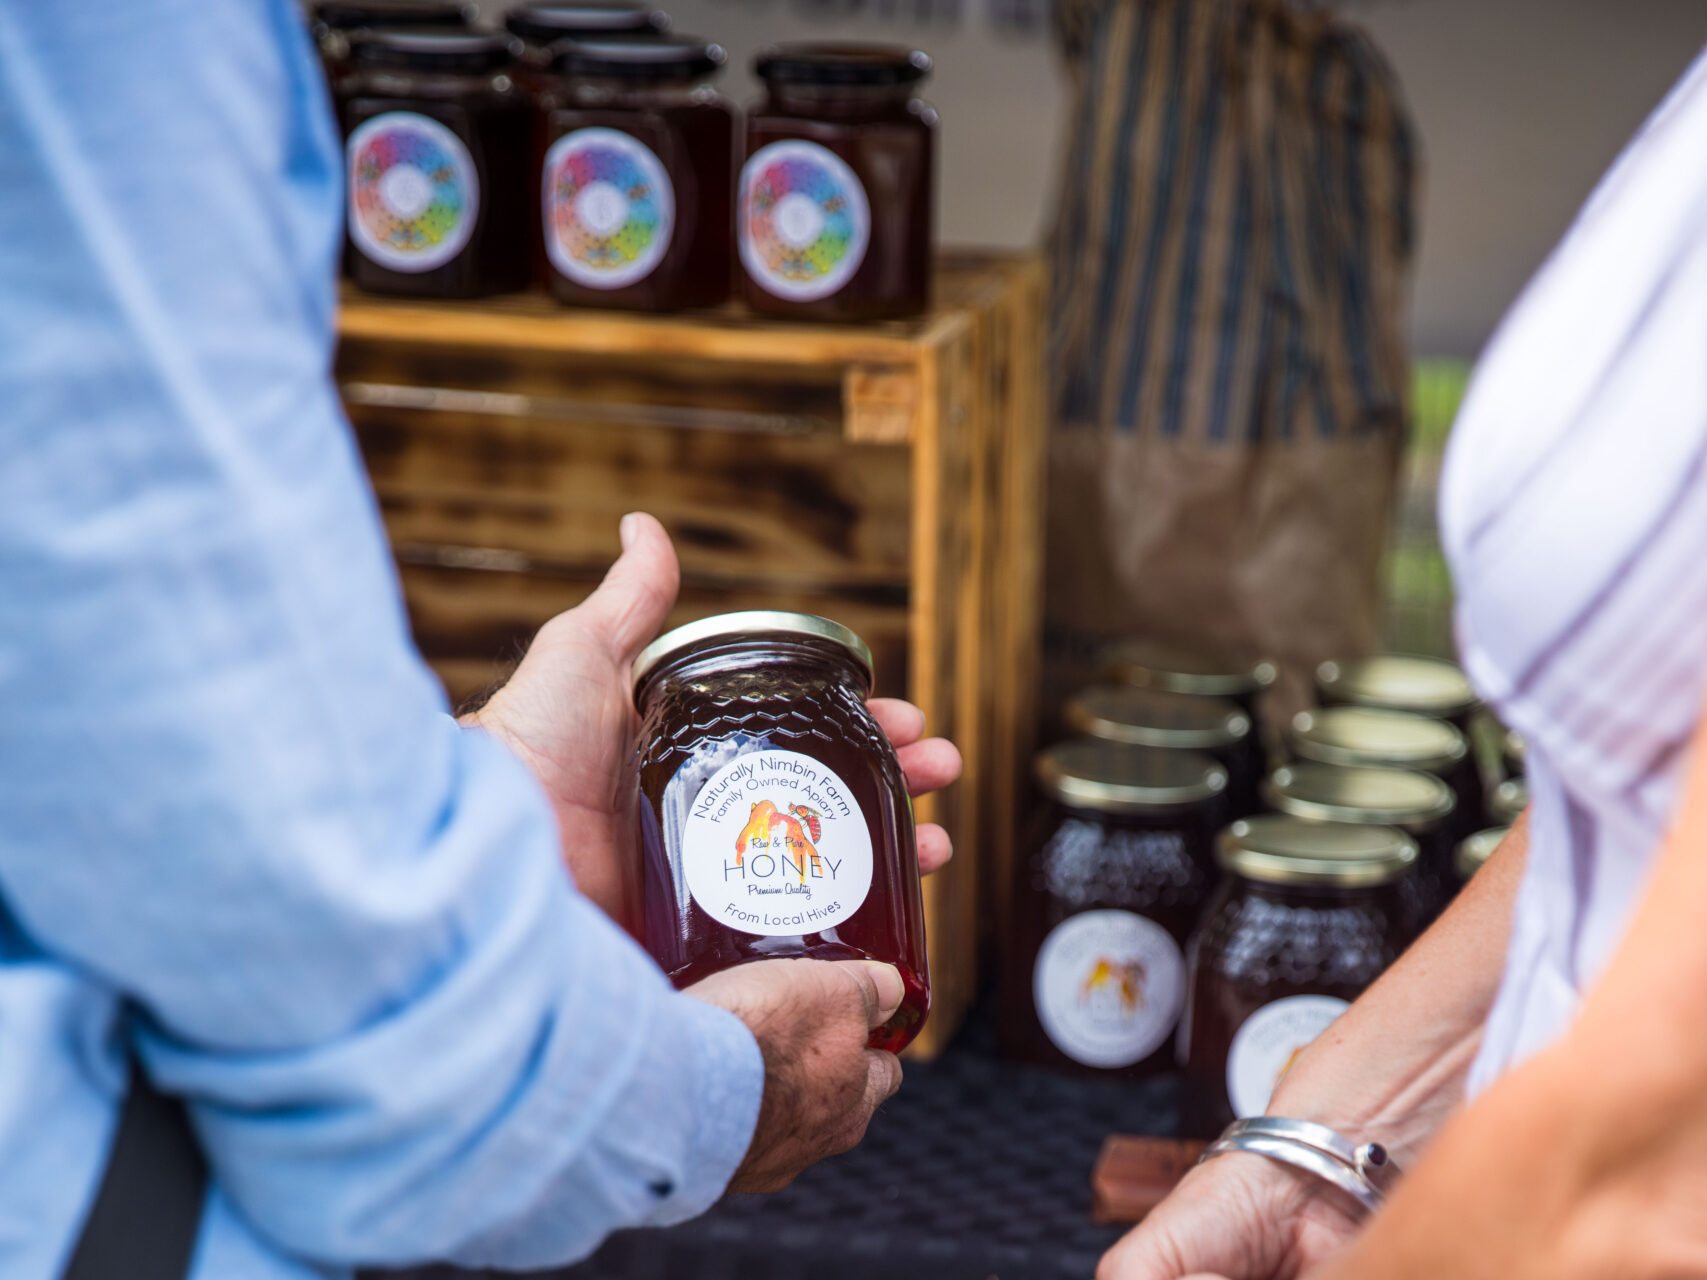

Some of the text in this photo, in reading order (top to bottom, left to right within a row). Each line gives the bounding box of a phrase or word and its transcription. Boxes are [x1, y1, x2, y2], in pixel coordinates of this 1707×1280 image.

[694, 758, 851, 818] Naturally Nimbin Farm
[711, 778, 837, 823] Family Owned Apiary
[751, 838, 769, 848] Raw
[773, 838, 781, 846] &
[724, 855, 842, 881] HONEY
[747, 883, 811, 899] Premium Quality
[724, 901, 841, 925] From Local Hives
